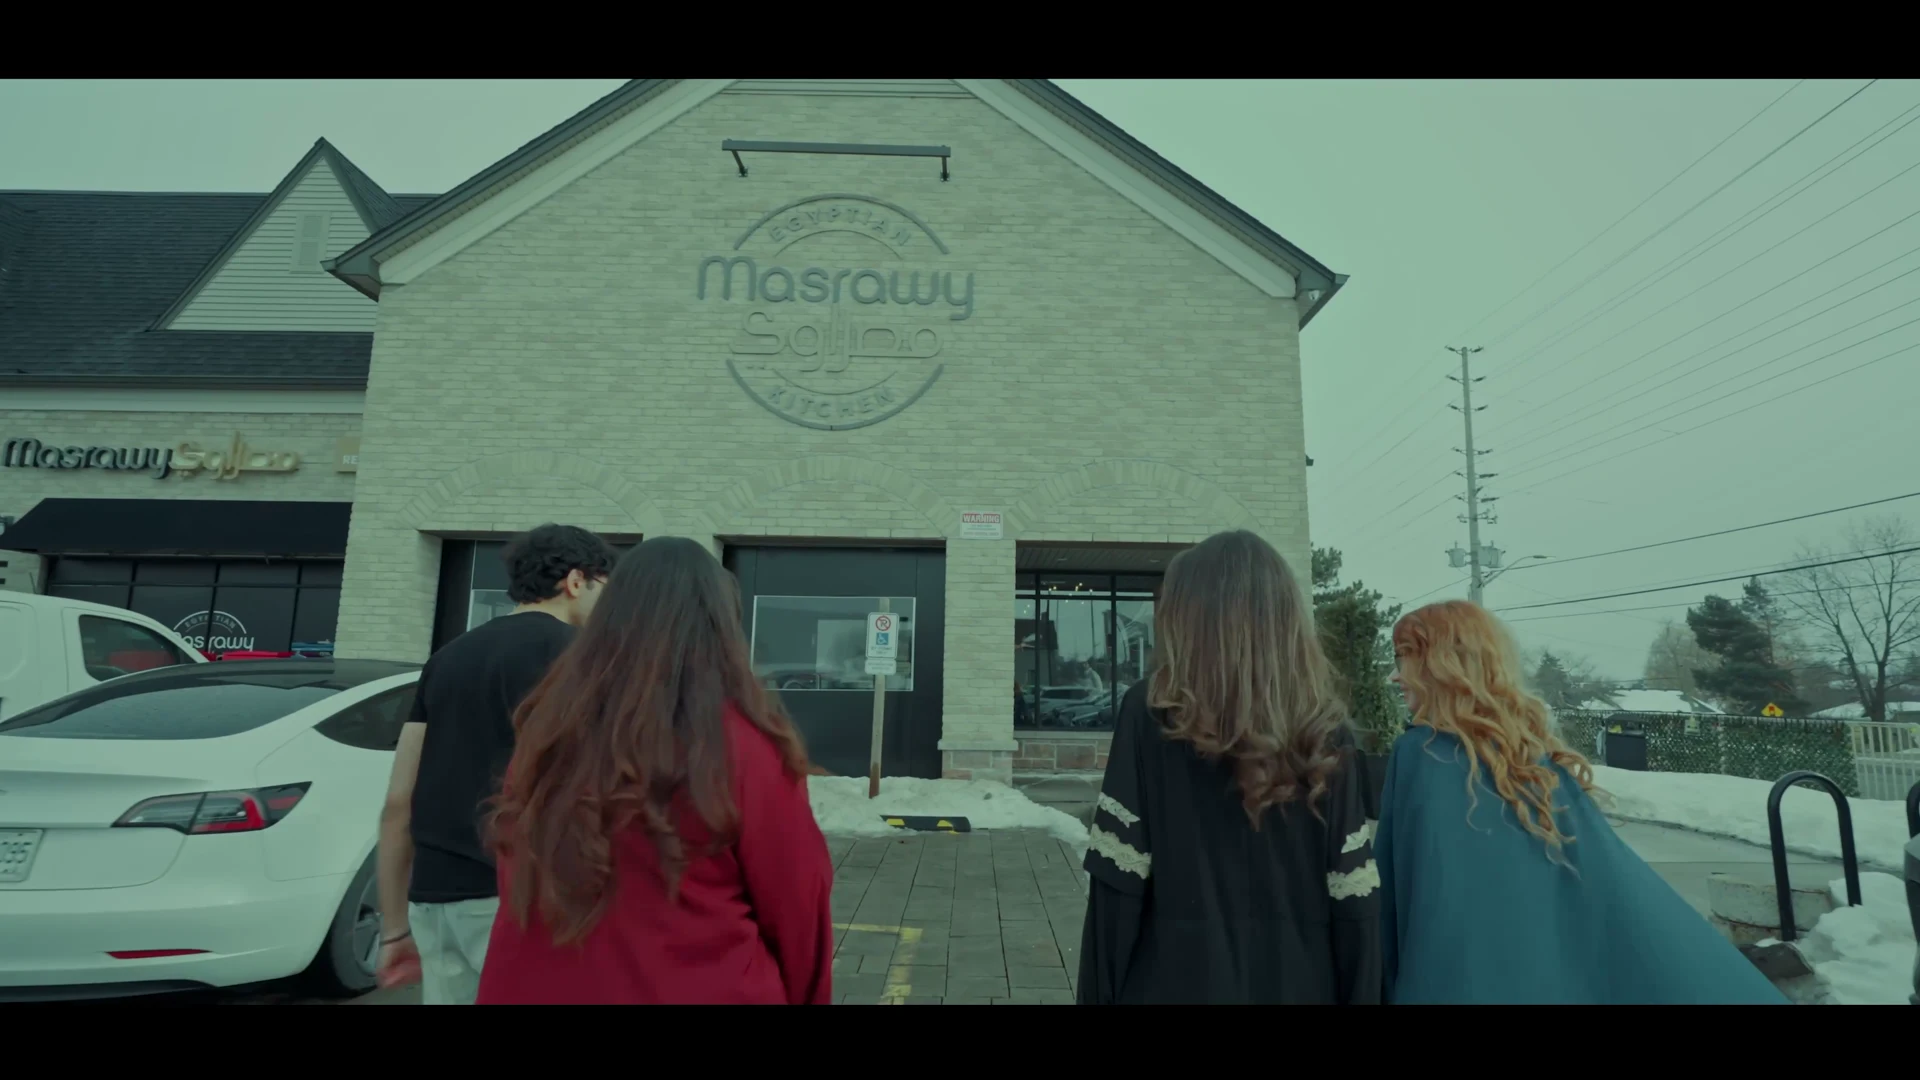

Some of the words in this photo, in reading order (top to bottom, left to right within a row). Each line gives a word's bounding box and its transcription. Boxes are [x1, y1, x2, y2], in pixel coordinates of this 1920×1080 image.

[769, 207, 912, 246] EGYPTIAN
[768, 386, 895, 418] KITCHEN
[963, 513, 1000, 523] WARNING
[175, 632, 254, 652] asrawy
